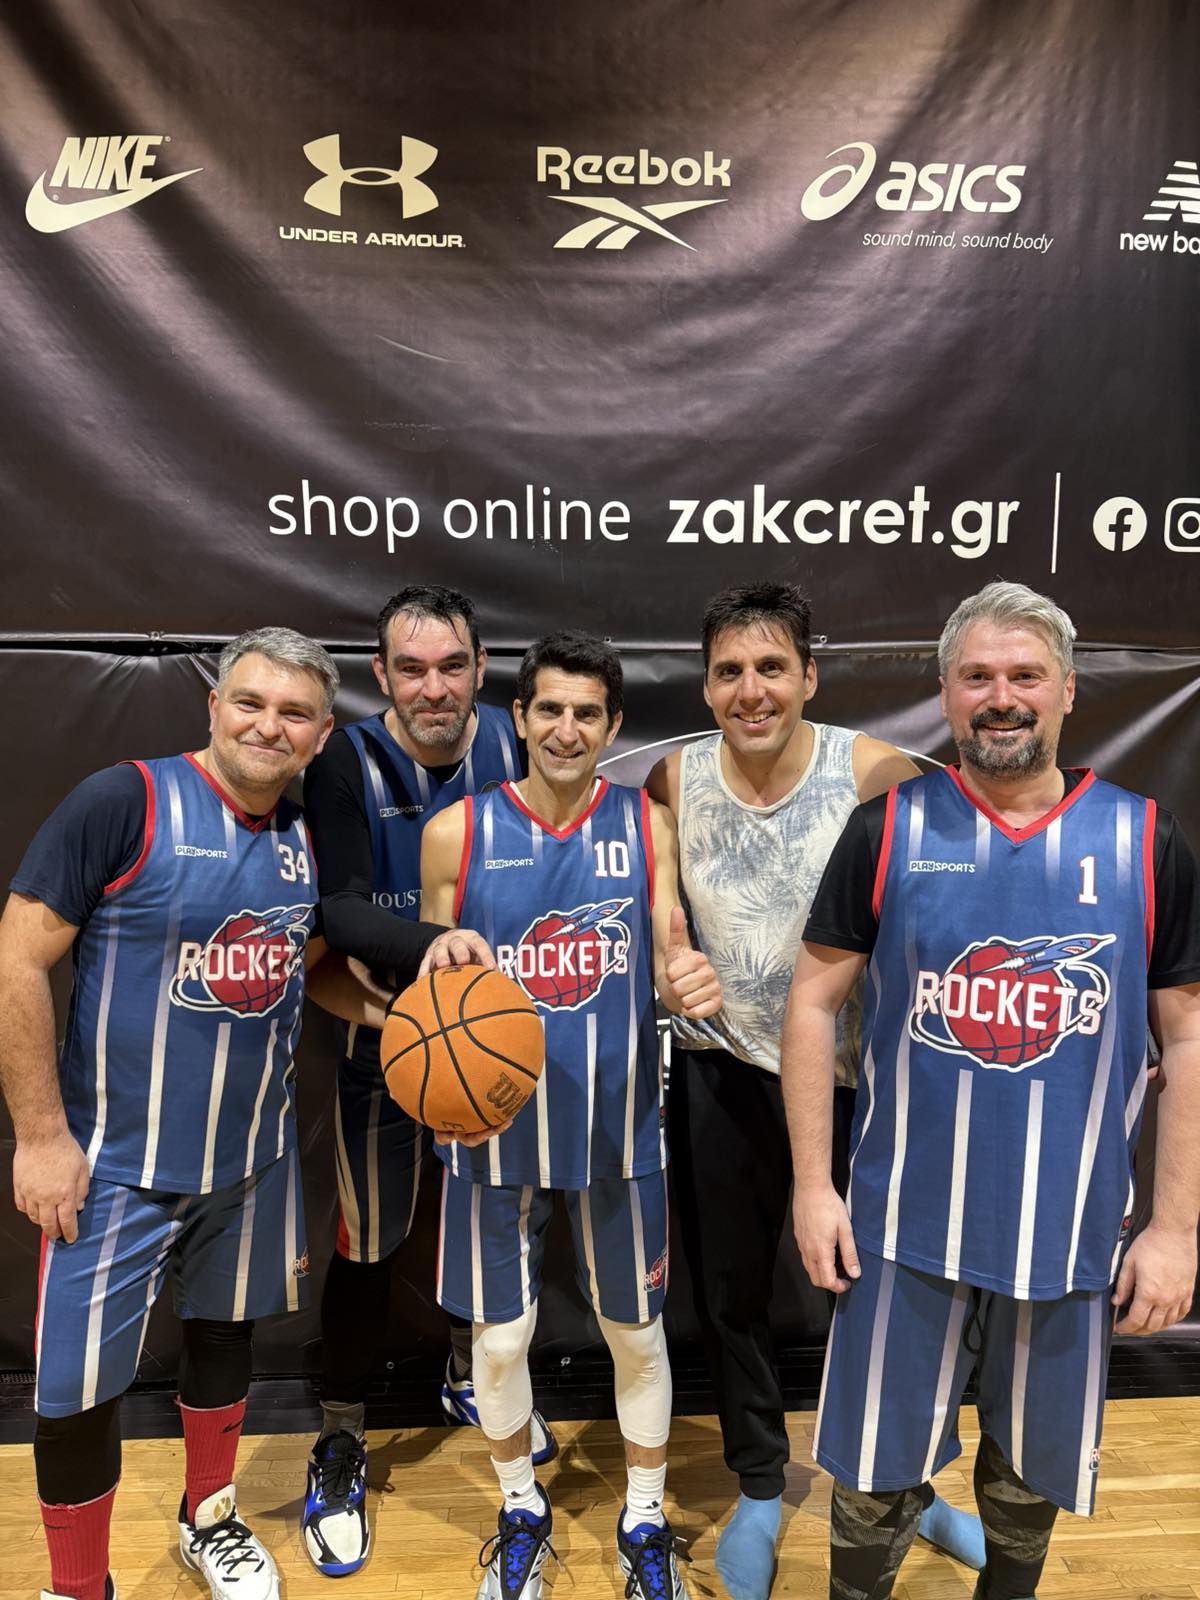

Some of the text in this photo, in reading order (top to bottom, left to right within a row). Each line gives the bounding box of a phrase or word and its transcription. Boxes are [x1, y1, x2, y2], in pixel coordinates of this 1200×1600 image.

[49, 135, 164, 191] NIKE
[536, 146, 732, 191] Reebok
[278, 226, 359, 245] UNDER
[862, 230, 1054, 254] sound mind, sound body
[1119, 232, 1169, 252] new
[267, 479, 1021, 560] shop online zakcret.gr
[278, 843, 311, 885] 34
[593, 840, 631, 878] 10
[909, 860, 976, 874] PLAYSPORTS
[1078, 855, 1098, 905] 1
[496, 940, 629, 979] ROCKETS
[914, 970, 1104, 1035] ROCKETS
